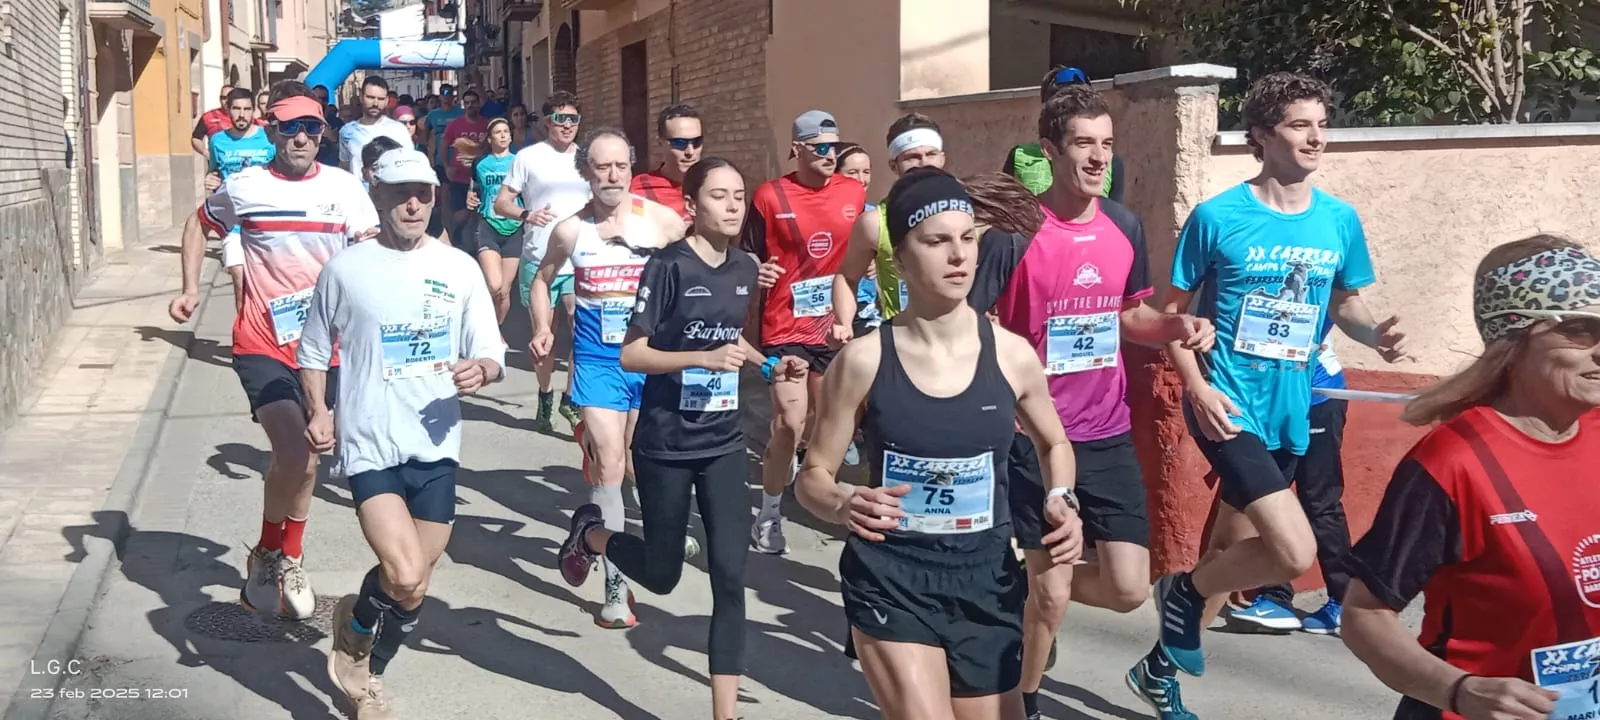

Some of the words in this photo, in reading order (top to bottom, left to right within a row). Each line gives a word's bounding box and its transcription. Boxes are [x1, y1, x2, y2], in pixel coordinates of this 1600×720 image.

[1269, 245, 1339, 264] CARRERA
[1246, 262, 1279, 272] CAMPO
[1244, 275, 1284, 285] FEBRERO
[811, 293, 825, 303] 56
[1073, 296, 1092, 309] THE
[1267, 322, 1290, 338] 83
[408, 341, 432, 356] 72
[1073, 336, 1094, 351] 42
[706, 377, 722, 391] 40
[888, 466, 919, 477] CAMPO
[891, 455, 910, 468] XX
[914, 456, 986, 473] CARRERA
[922, 485, 955, 506] 75
[1542, 649, 1569, 667] XX
